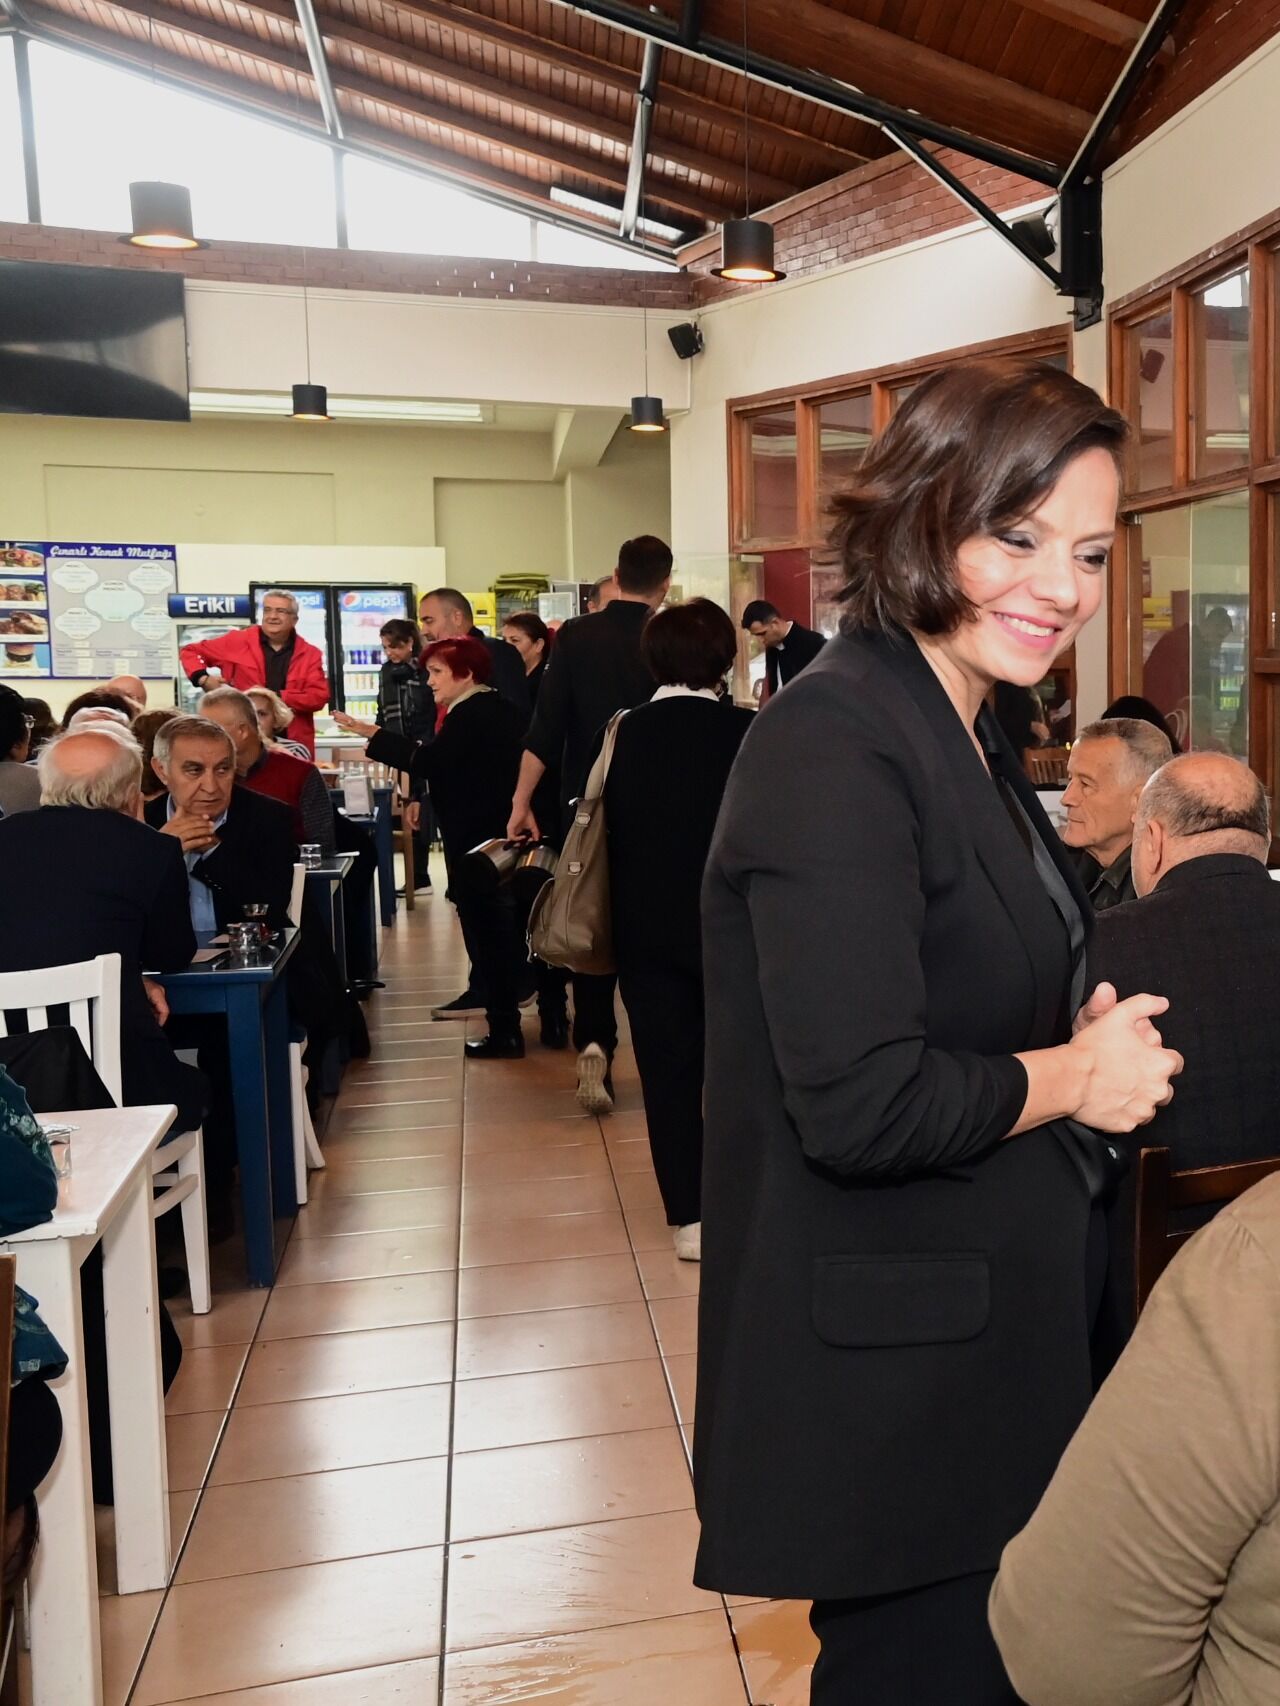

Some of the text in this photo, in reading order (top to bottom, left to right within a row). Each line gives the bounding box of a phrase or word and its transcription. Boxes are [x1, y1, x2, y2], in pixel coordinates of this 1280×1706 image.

[89, 546, 123, 557] Konak
[184, 596, 236, 614] Erikli
[363, 594, 401, 609] pepsi
